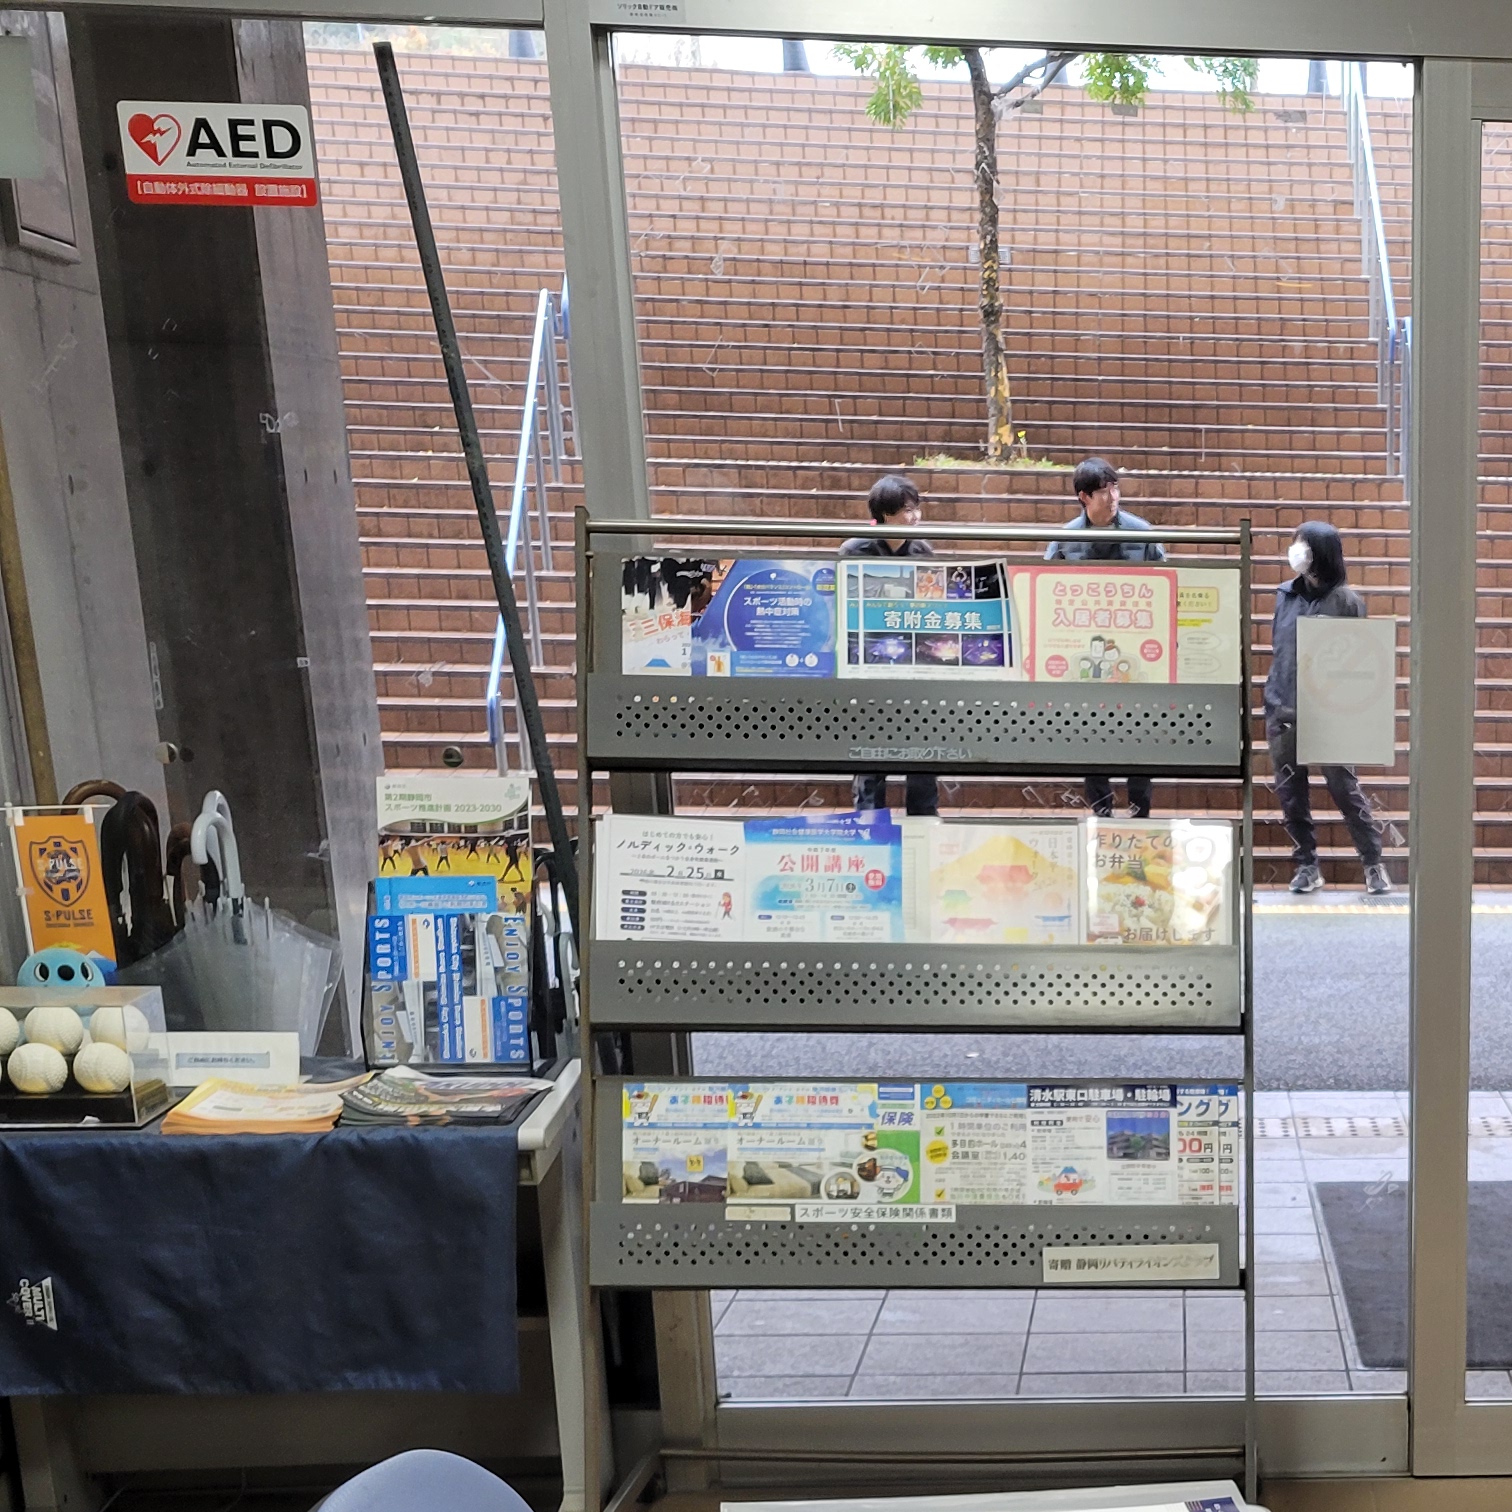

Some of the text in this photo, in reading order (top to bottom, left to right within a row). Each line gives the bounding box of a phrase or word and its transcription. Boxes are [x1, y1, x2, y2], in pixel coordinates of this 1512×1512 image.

[186, 117, 301, 159] AED
[1053, 581, 1154, 598] とっこうちん
[883, 610, 982, 630] 寄附金募集
[1053, 608, 1154, 629] 入居者募集
[848, 746, 973, 760] ご自由にお取り下さい
[454, 803, 502, 813] 2023-2030
[616, 840, 740, 856] ノルディック・ウォーク
[777, 854, 866, 874] 公開講座
[1096, 853, 1144, 870] お弁当
[1124, 927, 1216, 942] お届けします
[1029, 1088, 1171, 1102] 清水駅東口駐車場・駐輪場
[880, 1111, 915, 1126] 保険
[1222, 1143, 1233, 1154] 円
[799, 1206, 953, 1219] スポーツ安全保険関係書類
[1048, 1259, 1072, 1270] 寄贈
[19, 1278, 34, 1317] COVER
[31, 1286, 46, 1322] MULTI
